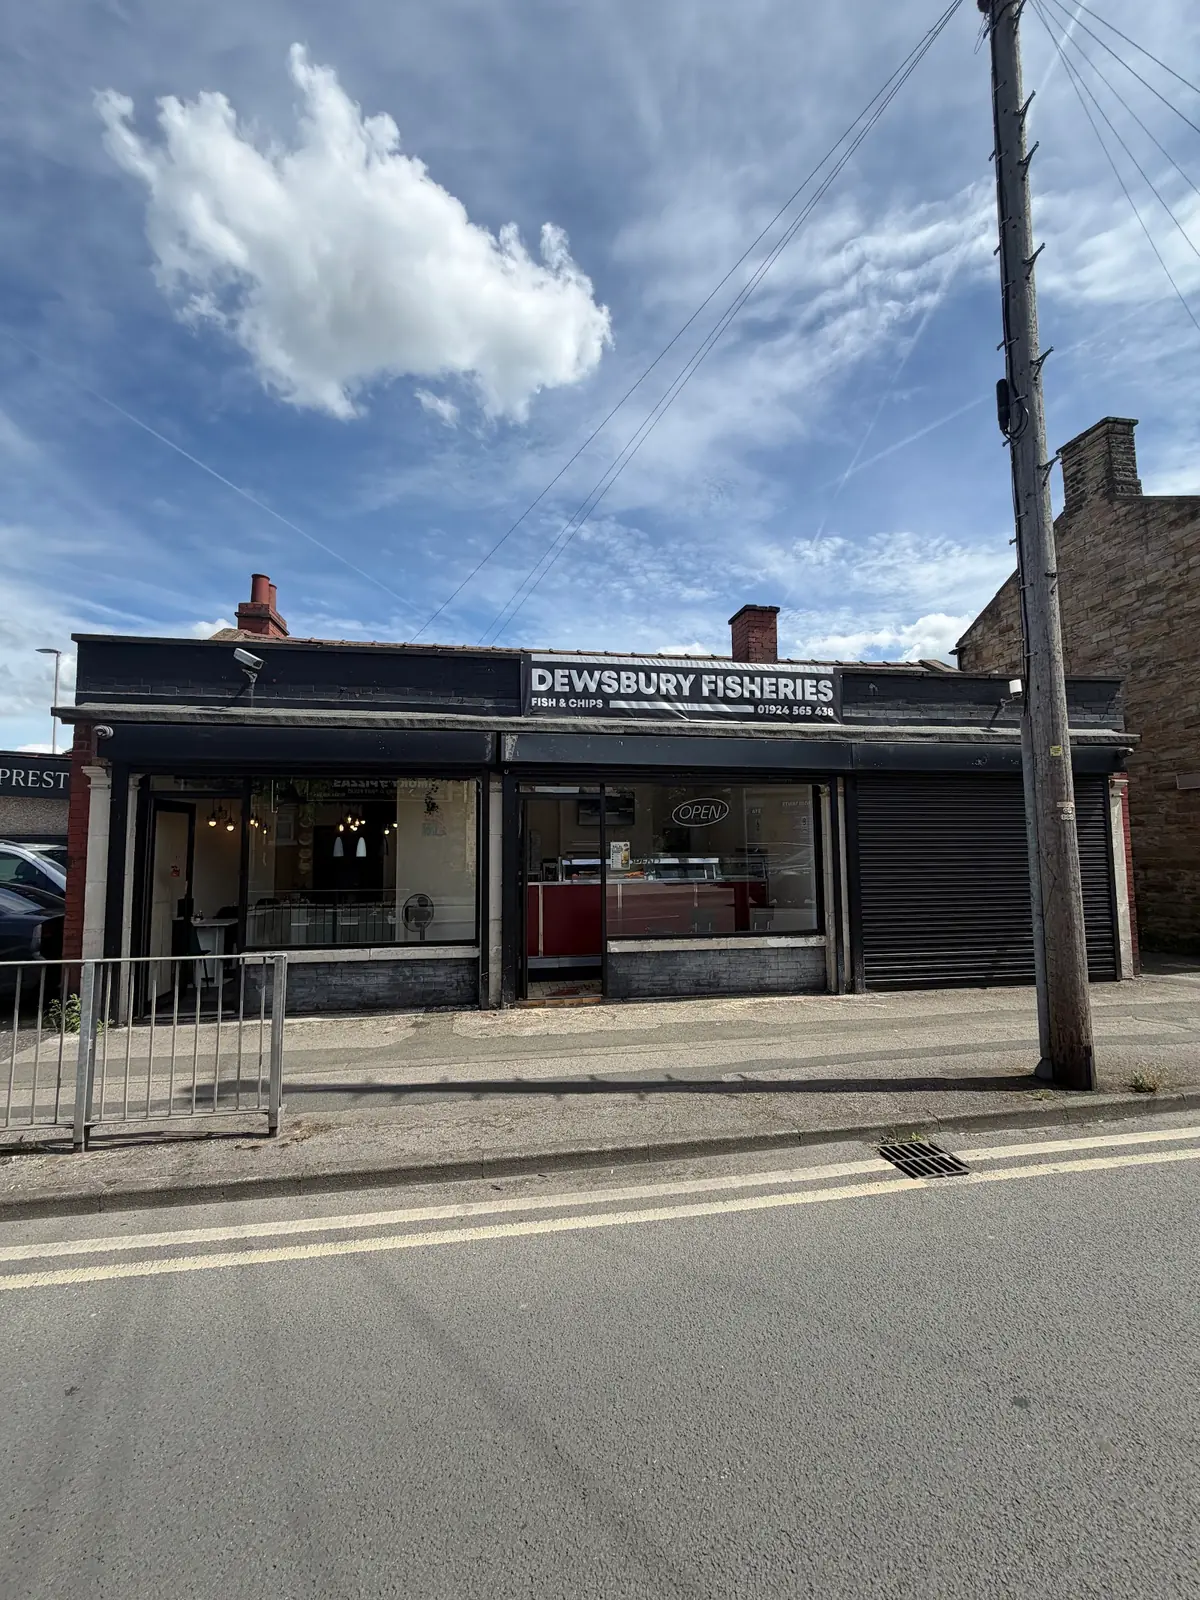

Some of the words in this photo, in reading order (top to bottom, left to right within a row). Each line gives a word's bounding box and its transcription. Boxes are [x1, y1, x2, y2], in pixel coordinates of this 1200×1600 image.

[531, 668, 696, 697] DEWSBURY
[702, 674, 834, 702] FISHERIES
[531, 697, 557, 708] FISH
[559, 698, 567, 708] &
[568, 698, 604, 709] CHIPS
[757, 704, 790, 715] 01924
[792, 706, 812, 716] 565
[814, 707, 834, 718] 438
[0, 768, 69, 789] PREST
[679, 804, 722, 820] OPEN
